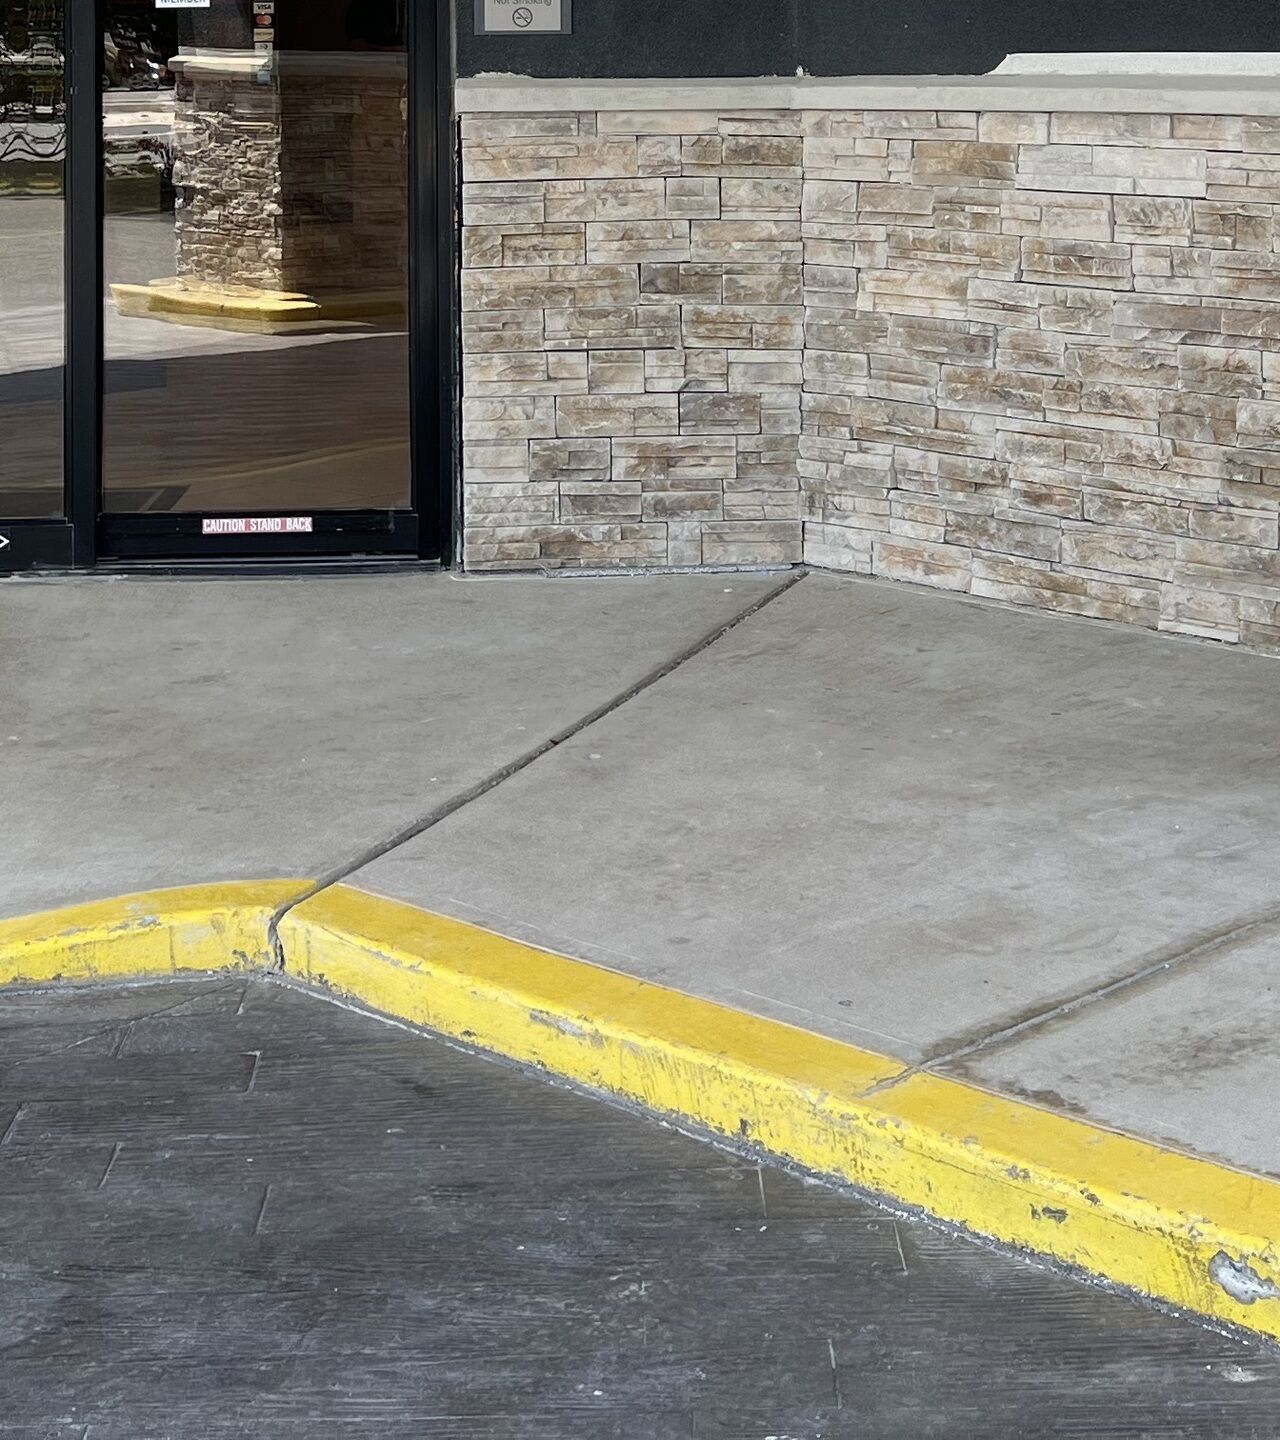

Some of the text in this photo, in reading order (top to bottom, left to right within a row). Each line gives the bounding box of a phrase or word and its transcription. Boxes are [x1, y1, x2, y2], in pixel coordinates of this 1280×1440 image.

[204, 518, 312, 532] CAUTION STAND BACK
